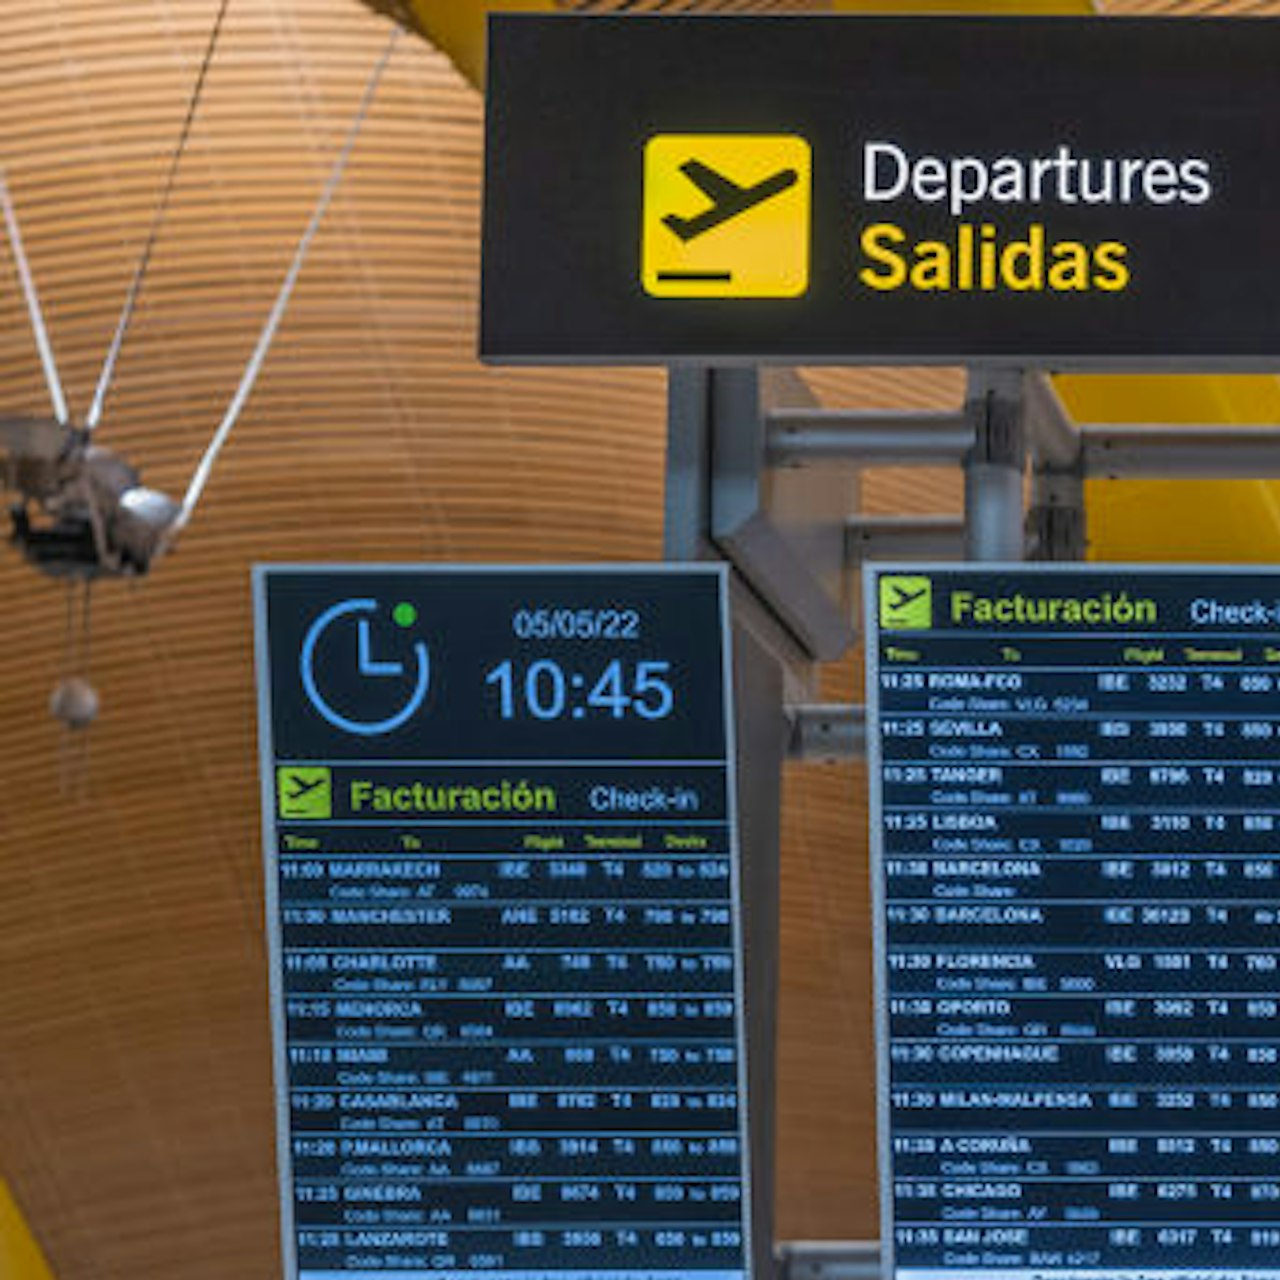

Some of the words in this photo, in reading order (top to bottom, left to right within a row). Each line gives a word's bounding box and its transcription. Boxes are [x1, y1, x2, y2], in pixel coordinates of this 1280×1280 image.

[862, 143, 1210, 215] Departures
[859, 224, 1129, 291] Salidas
[514, 610, 639, 639] 05/05/22
[951, 593, 1156, 623] Facturación
[486, 662, 673, 720] 10:45
[350, 781, 556, 811] Facturación
[591, 787, 699, 811] Check-in
